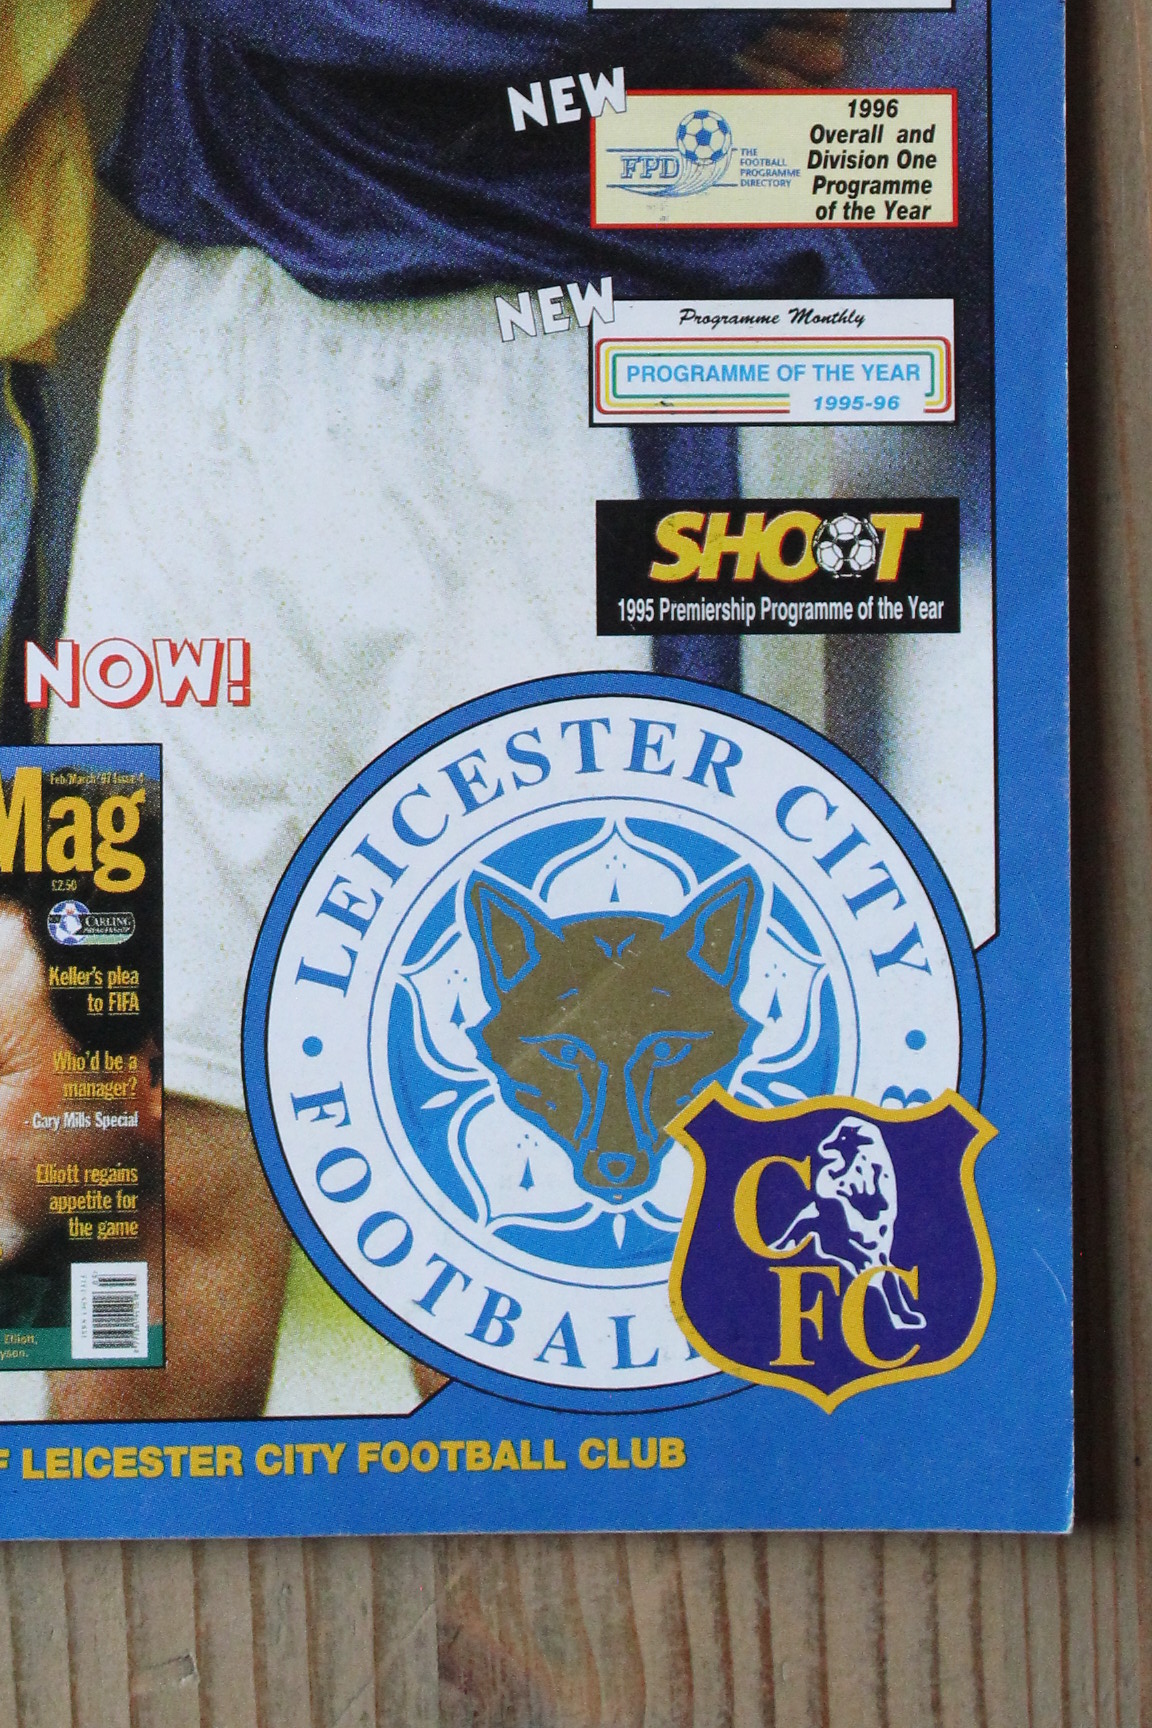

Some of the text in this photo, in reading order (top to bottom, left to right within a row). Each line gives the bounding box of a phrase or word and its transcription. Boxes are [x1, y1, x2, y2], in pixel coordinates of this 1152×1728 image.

[507, 67, 626, 132] NEW
[848, 98, 899, 118] 1996
[810, 124, 936, 144] Overall and
[740, 158, 786, 166] FOOTBALL
[741, 148, 758, 156] THE
[808, 149, 937, 169] Division One
[621, 155, 680, 179] FPD
[740, 169, 800, 177] PROGRAMME
[741, 179, 791, 187] DIRECTORY
[812, 175, 932, 199] Programme
[816, 200, 931, 220] of the Year
[495, 277, 615, 342] NEW
[678, 307, 865, 328] Programme Monthly
[626, 364, 920, 382] PROGRAMME OF THE YEAR
[813, 395, 900, 411] 1995-96
[618, 595, 944, 627] 1995 Premiership Programme of the Year
[24, 638, 252, 710] NOW!
[294, 716, 933, 998] LEICESTER CITY
[52, 879, 77, 891] £2.50
[49, 966, 139, 989] Keller's plea
[88, 991, 140, 1012] to FIFA
[53, 1051, 123, 1072] Who'd be
[63, 1077, 137, 1100] manager?
[32, 1111, 139, 1131] Gary Mills Special
[36, 1162, 139, 1187] Elliott regains
[49, 1189, 138, 1213] appetite for
[68, 1217, 139, 1240] the game
[290, 1081, 712, 1372] FOOTBAL
[22, 1444, 245, 1481] LEICESTER
[255, 1441, 347, 1476] CITY
[357, 1438, 567, 1475] FOOTBALL
[578, 1436, 687, 1472] CLUB
